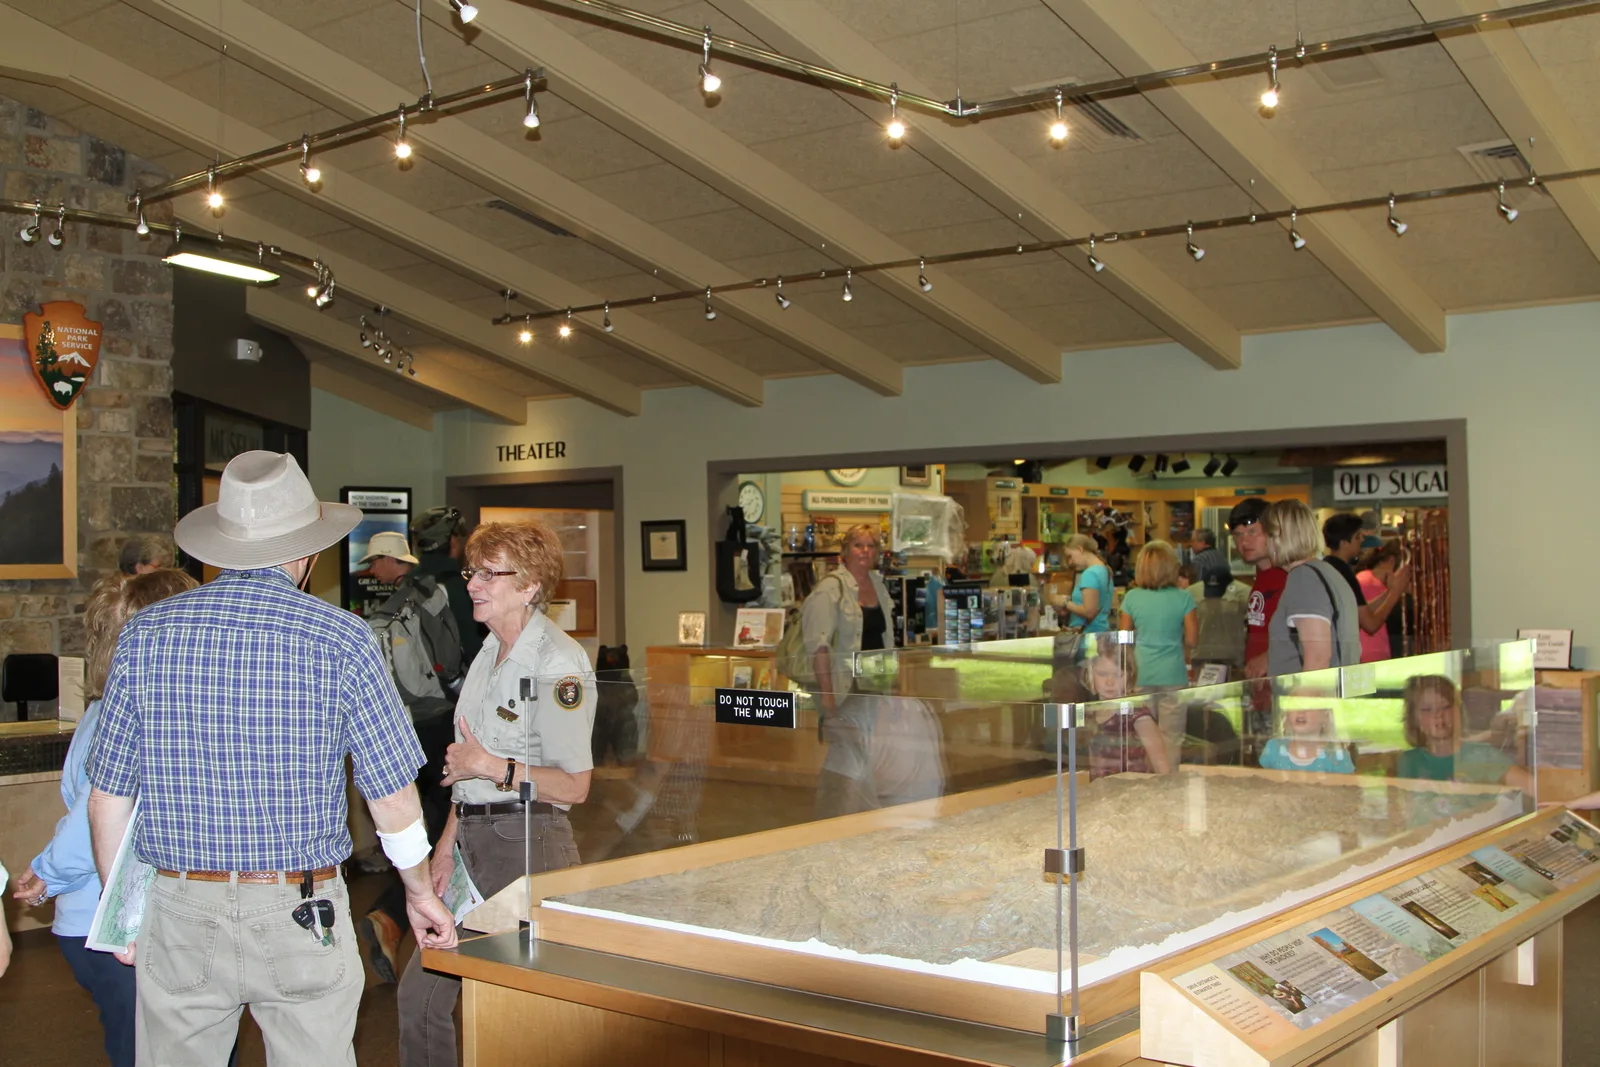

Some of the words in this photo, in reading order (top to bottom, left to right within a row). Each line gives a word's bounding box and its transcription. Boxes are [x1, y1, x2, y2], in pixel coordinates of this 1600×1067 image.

[57, 326, 98, 336] NATIONAL
[62, 342, 93, 350] SERVICE
[496, 441, 566, 462] THEATER
[1340, 472, 1380, 495] OLD
[720, 694, 732, 704] DO
[736, 696, 753, 706] NOT
[758, 698, 788, 708] TOUCH
[734, 707, 750, 718] THE
[756, 709, 774, 718] MAP
[1276, 944, 1294, 953] PEOPLE
